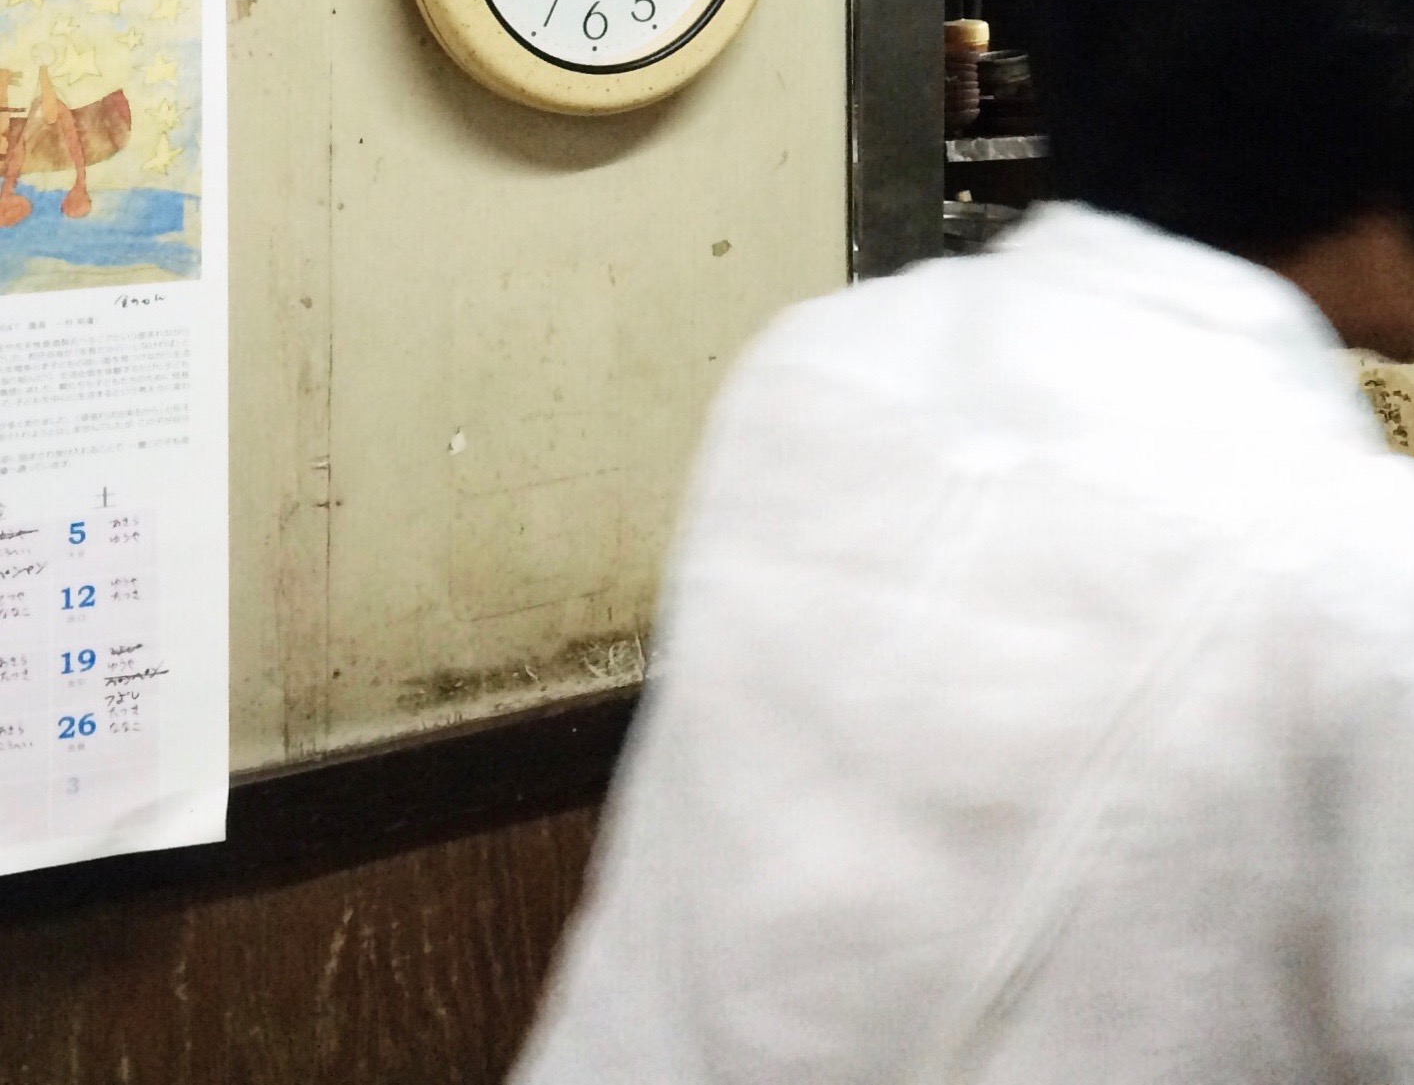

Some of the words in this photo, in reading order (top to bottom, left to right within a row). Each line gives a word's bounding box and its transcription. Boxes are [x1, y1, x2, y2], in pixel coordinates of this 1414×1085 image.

[583, 1, 608, 40] 6
[68, 521, 87, 545] 5
[61, 585, 97, 610] 12
[61, 649, 97, 675] 19
[58, 713, 97, 740] 26
[67, 777, 80, 794] 3
